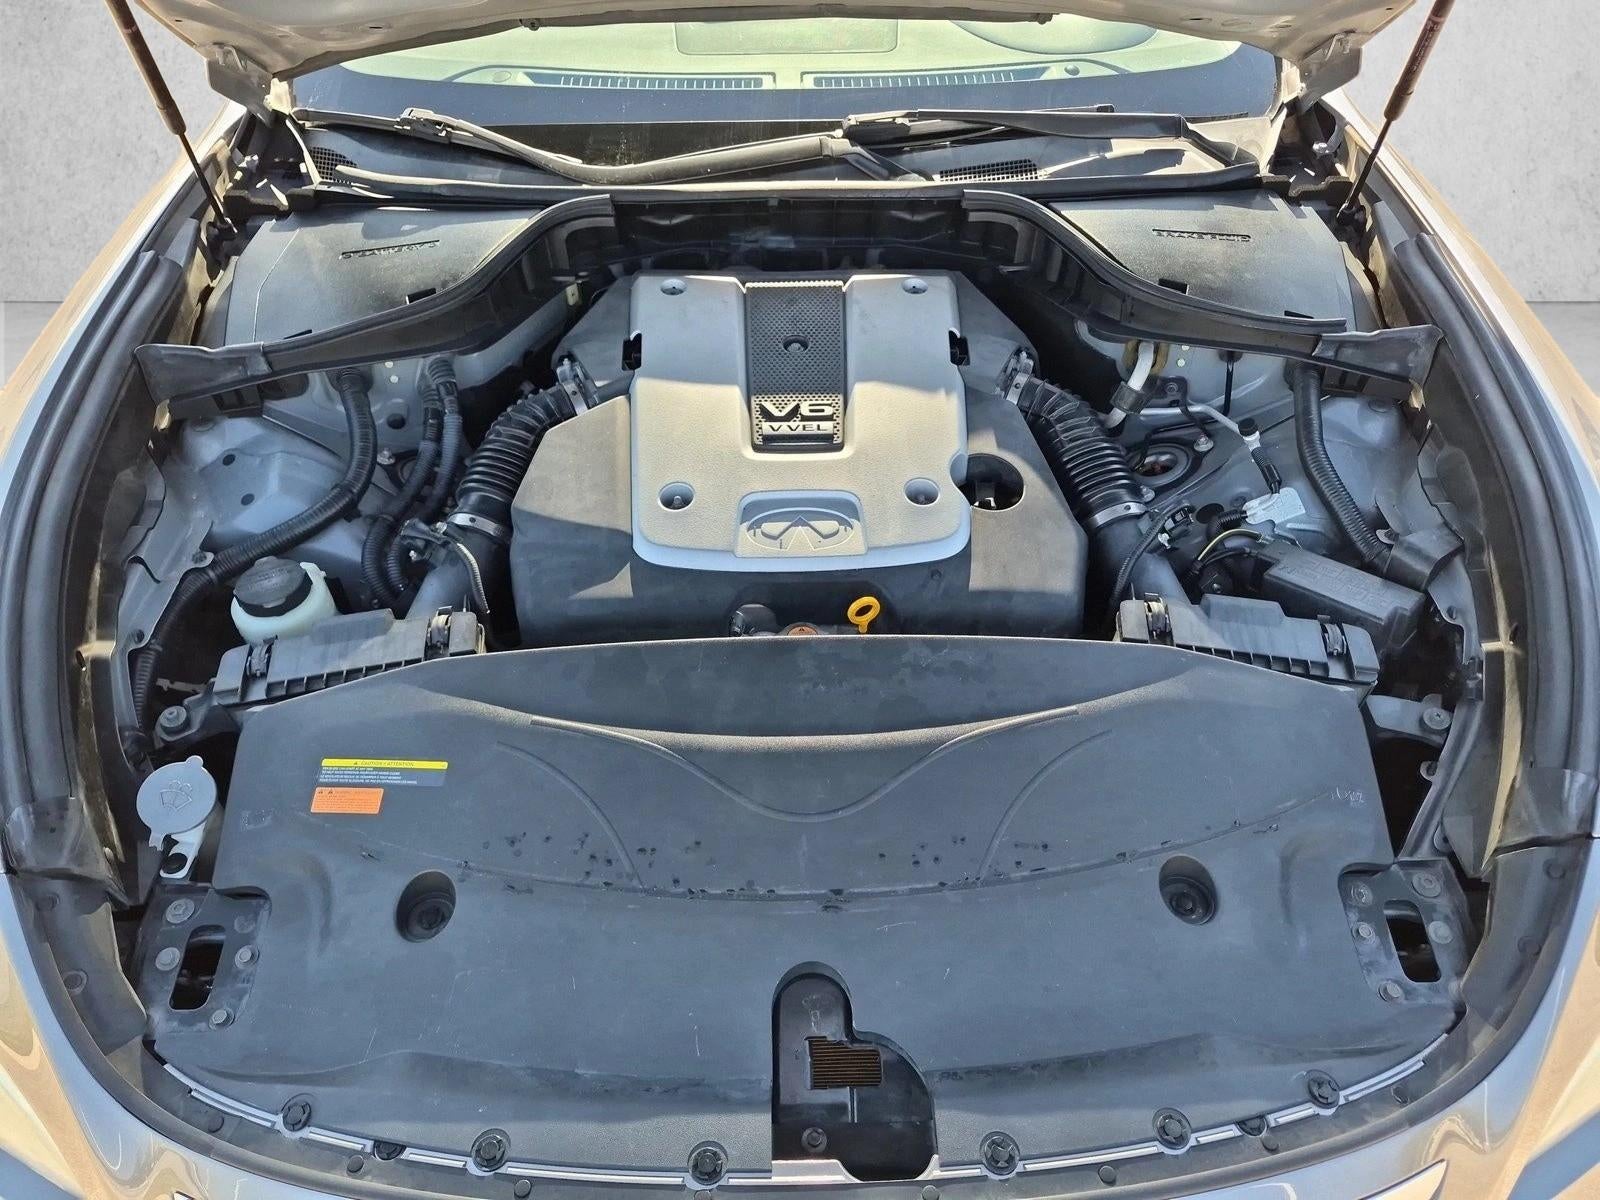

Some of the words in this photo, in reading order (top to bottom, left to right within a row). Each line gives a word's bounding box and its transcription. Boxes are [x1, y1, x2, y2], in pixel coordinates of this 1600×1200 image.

[1157, 231, 1204, 239] BRAKE
[1211, 233, 1250, 242] FLUID
[760, 400, 834, 420] V6
[768, 424, 829, 432] VVEL
